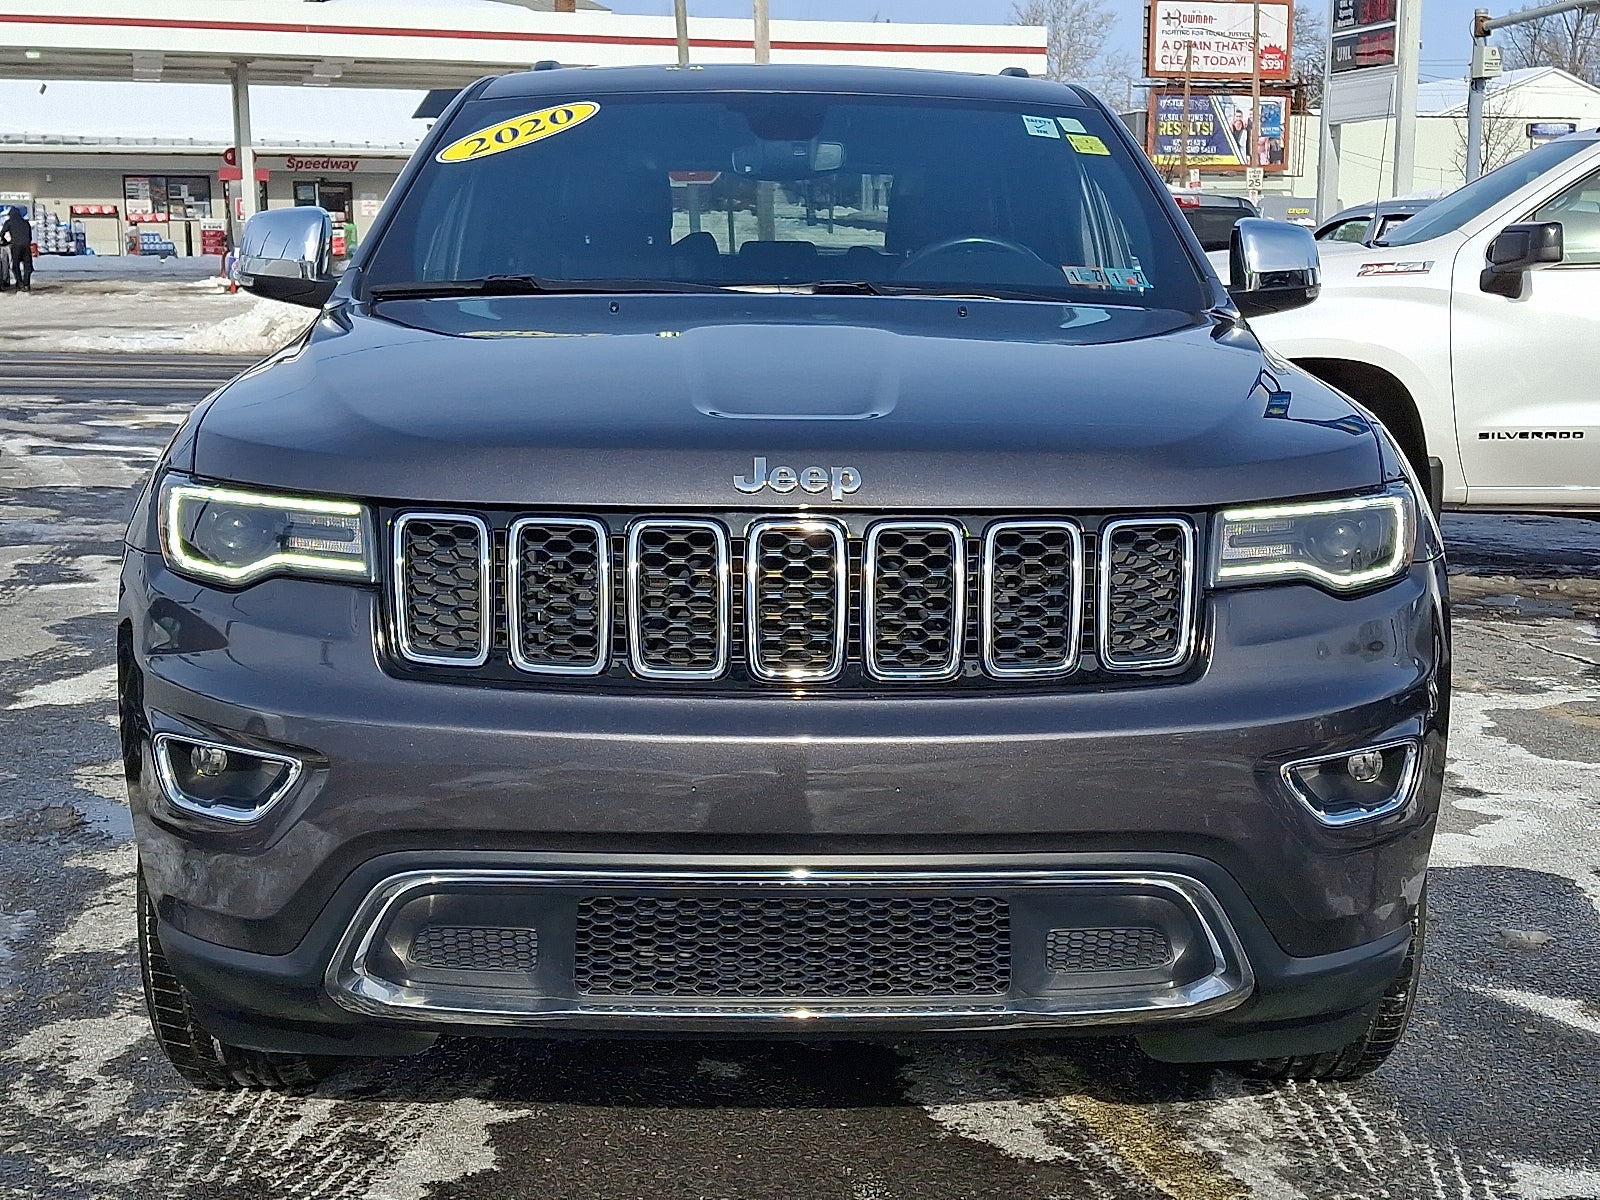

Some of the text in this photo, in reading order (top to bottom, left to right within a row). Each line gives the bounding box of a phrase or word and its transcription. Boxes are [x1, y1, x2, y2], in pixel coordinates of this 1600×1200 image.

[1161, 40, 1170, 50] A
[1215, 41, 1256, 52] THAT'S
[1203, 56, 1247, 67] TODAY!
[464, 108, 574, 156] 2020
[286, 156, 359, 172] Speedway
[1248, 179, 1261, 187] 25
[1478, 431, 1584, 440] SILVERADO
[733, 457, 862, 501] Jeep
